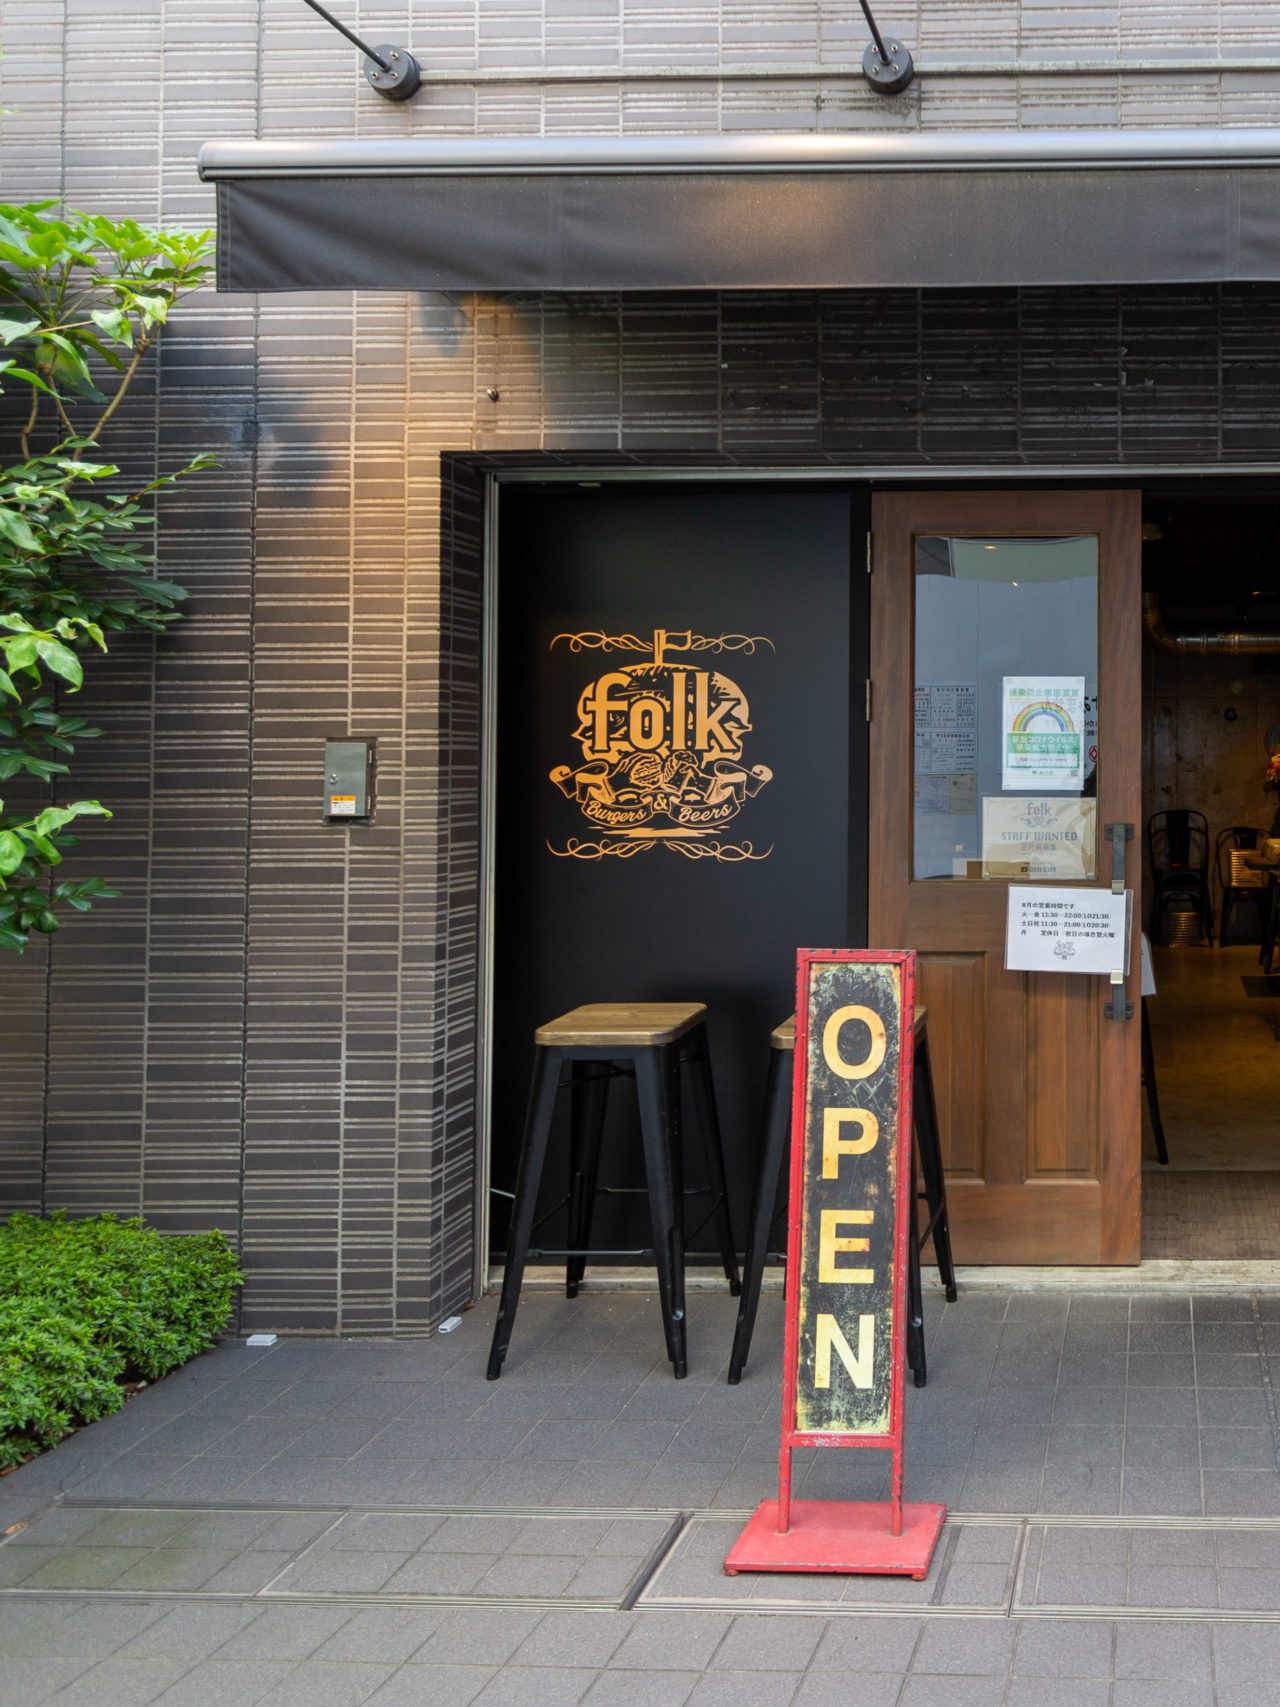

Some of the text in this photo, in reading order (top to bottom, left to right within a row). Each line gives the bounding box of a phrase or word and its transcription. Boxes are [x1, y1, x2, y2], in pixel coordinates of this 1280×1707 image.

[586, 672, 741, 751] folk
[1013, 736, 1075, 744] 新型コロナウイルス
[586, 793, 733, 824] Burgers & Beers
[1026, 801, 1052, 816] folk
[1001, 831, 1078, 841] STAFF WANTED
[814, 1004, 887, 1390] OPEN
